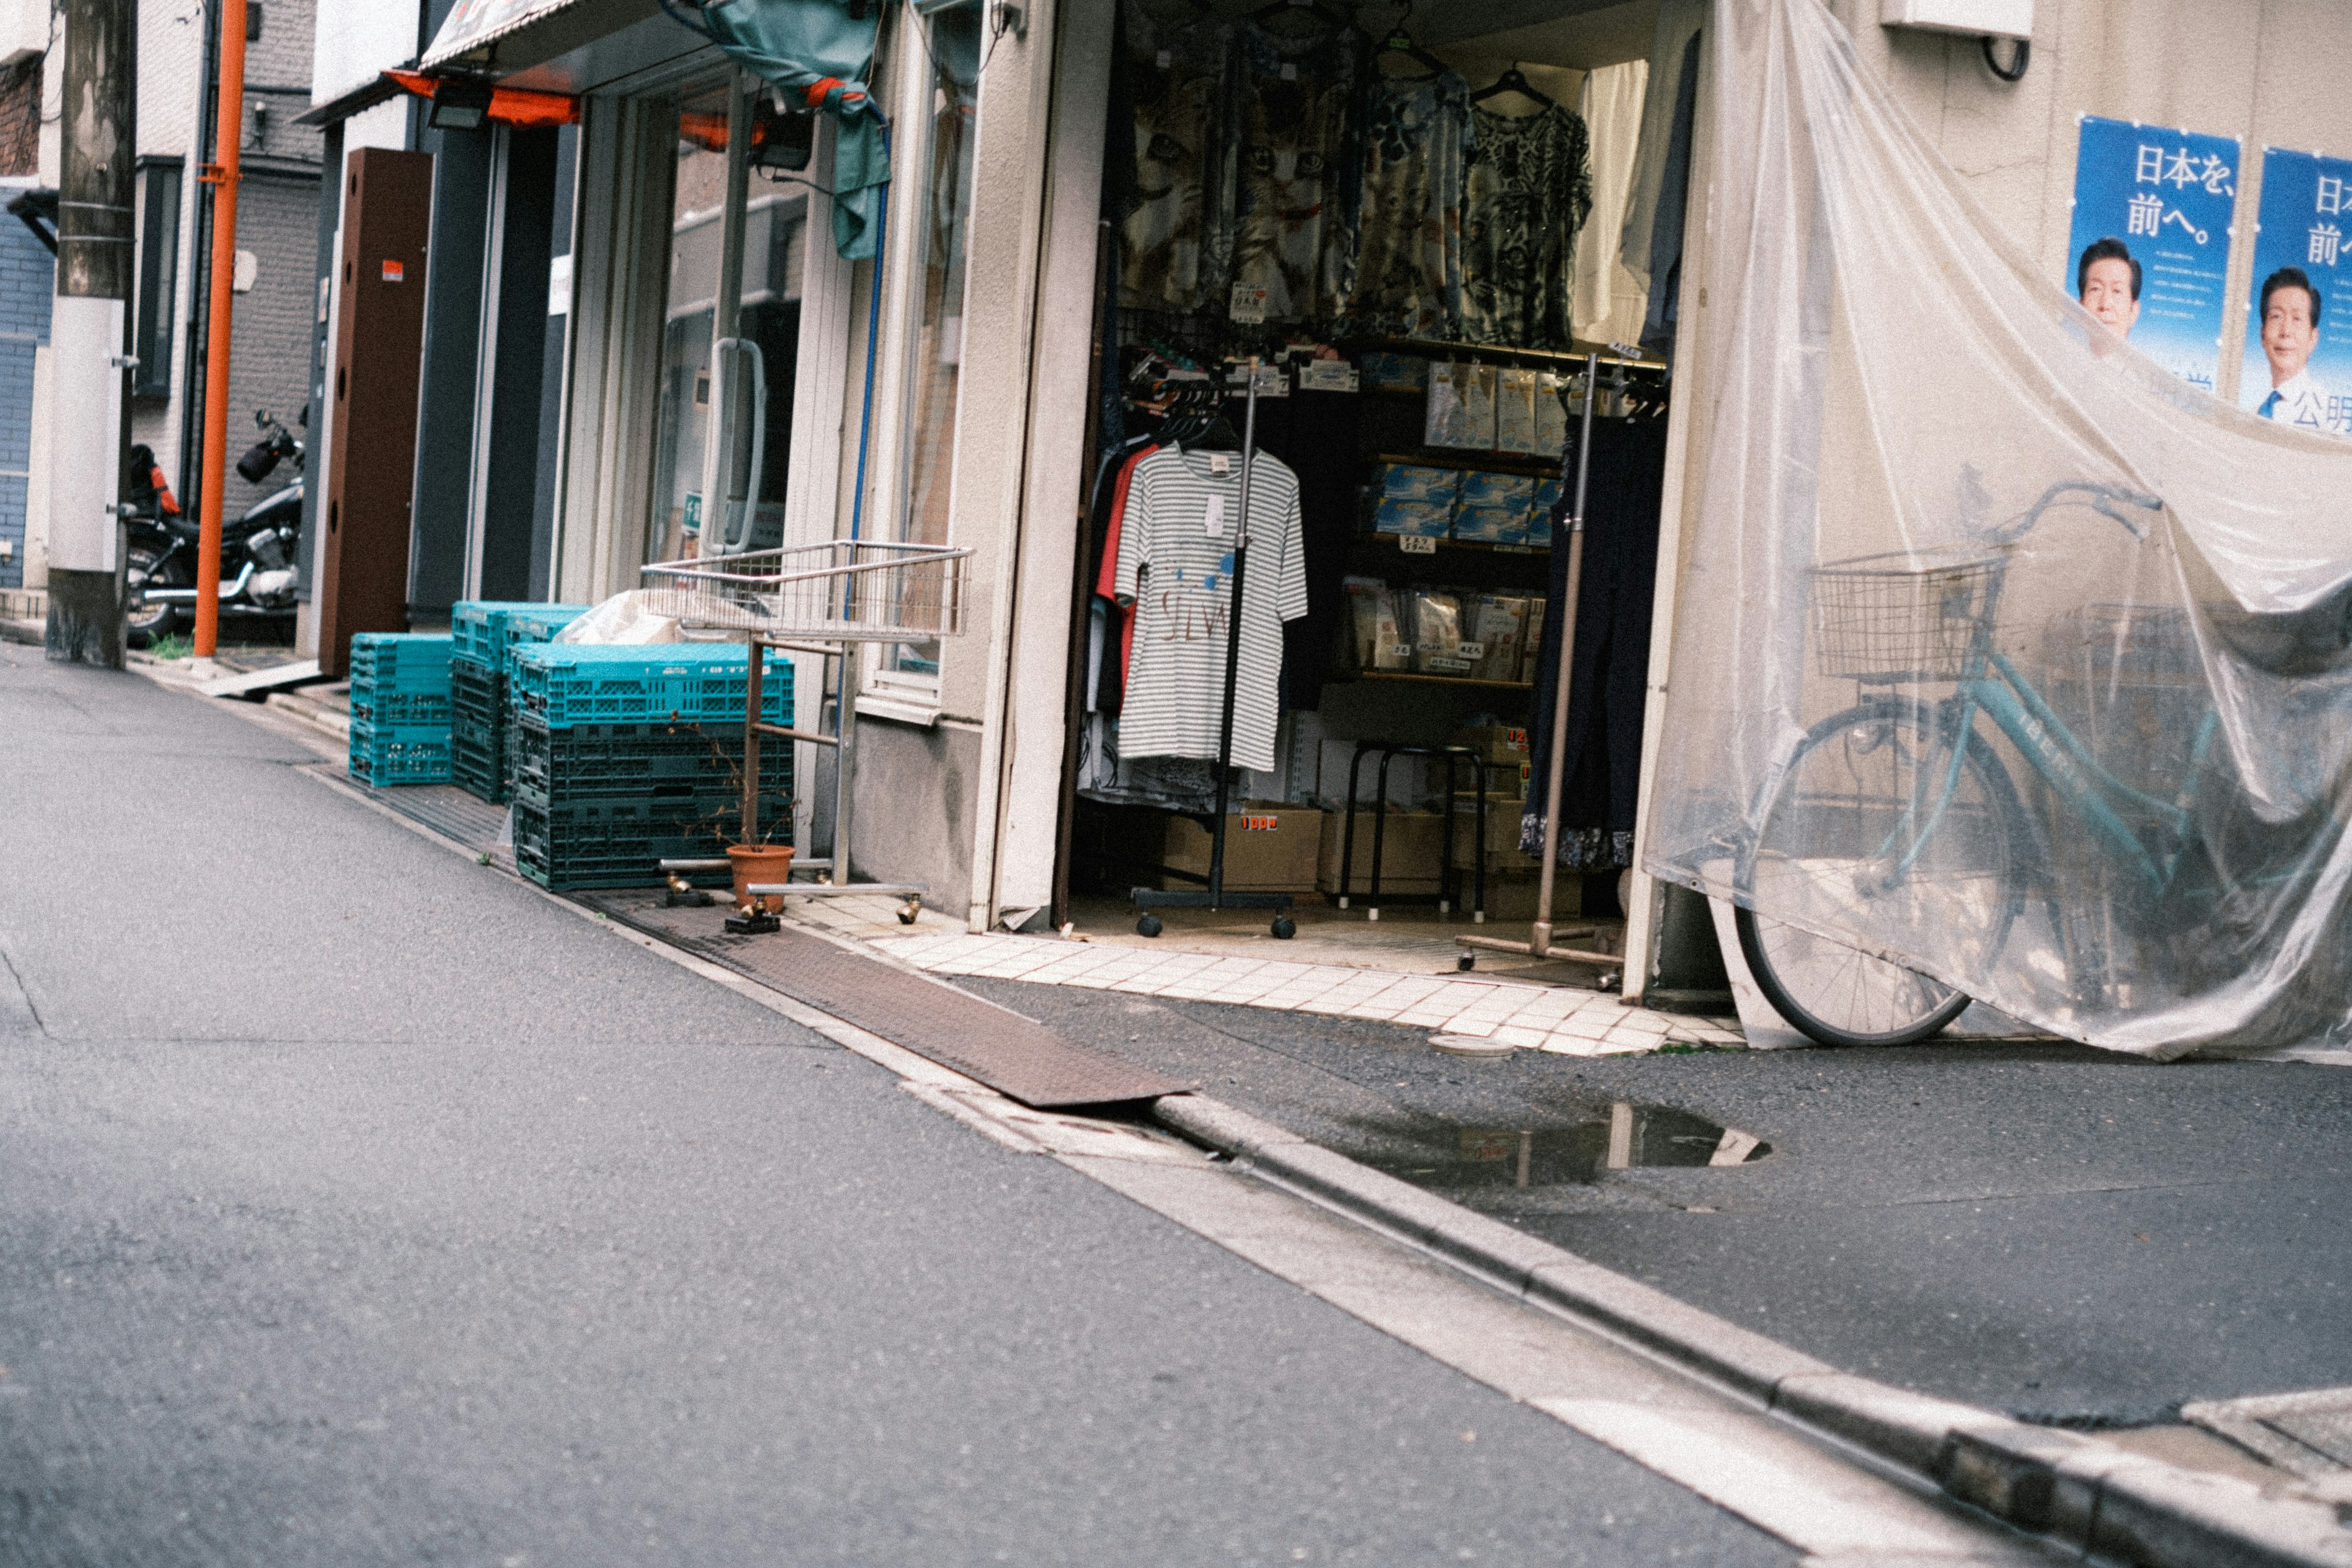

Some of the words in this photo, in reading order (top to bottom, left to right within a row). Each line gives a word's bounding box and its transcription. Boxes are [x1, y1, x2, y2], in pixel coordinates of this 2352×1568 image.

[2135, 145, 2234, 196] 日本を、
[2127, 192, 2209, 245] 前へ。
